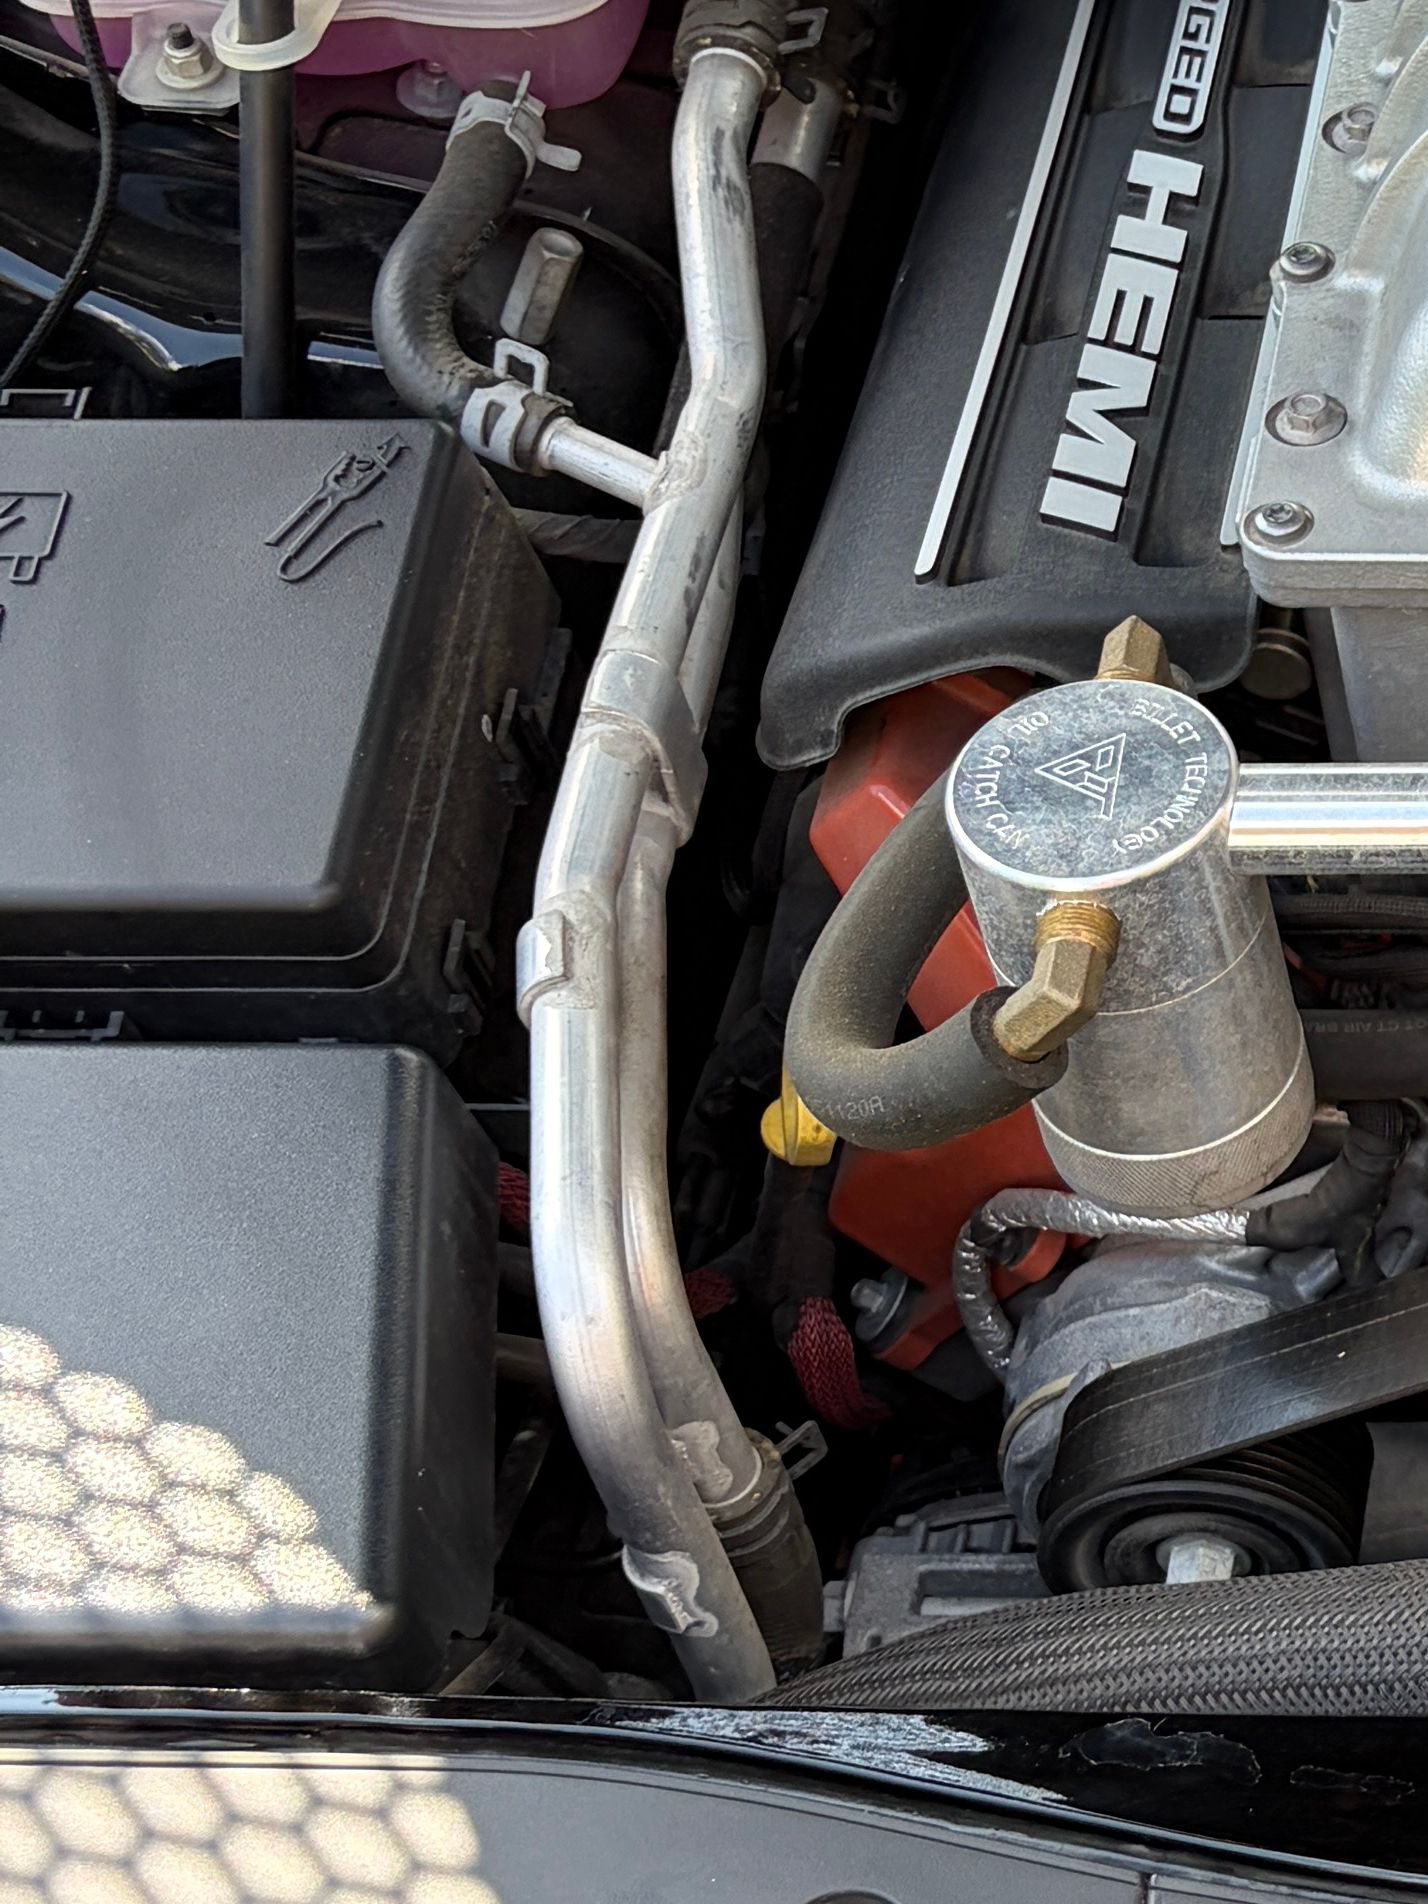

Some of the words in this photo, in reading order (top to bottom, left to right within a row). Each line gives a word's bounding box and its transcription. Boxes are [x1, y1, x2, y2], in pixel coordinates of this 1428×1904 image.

[1041, 149, 1202, 533] HEMI
[1130, 699, 1200, 745] BILLET
[974, 744, 1010, 808] CATCH
[1113, 752, 1208, 856] TECHNOLOGY
